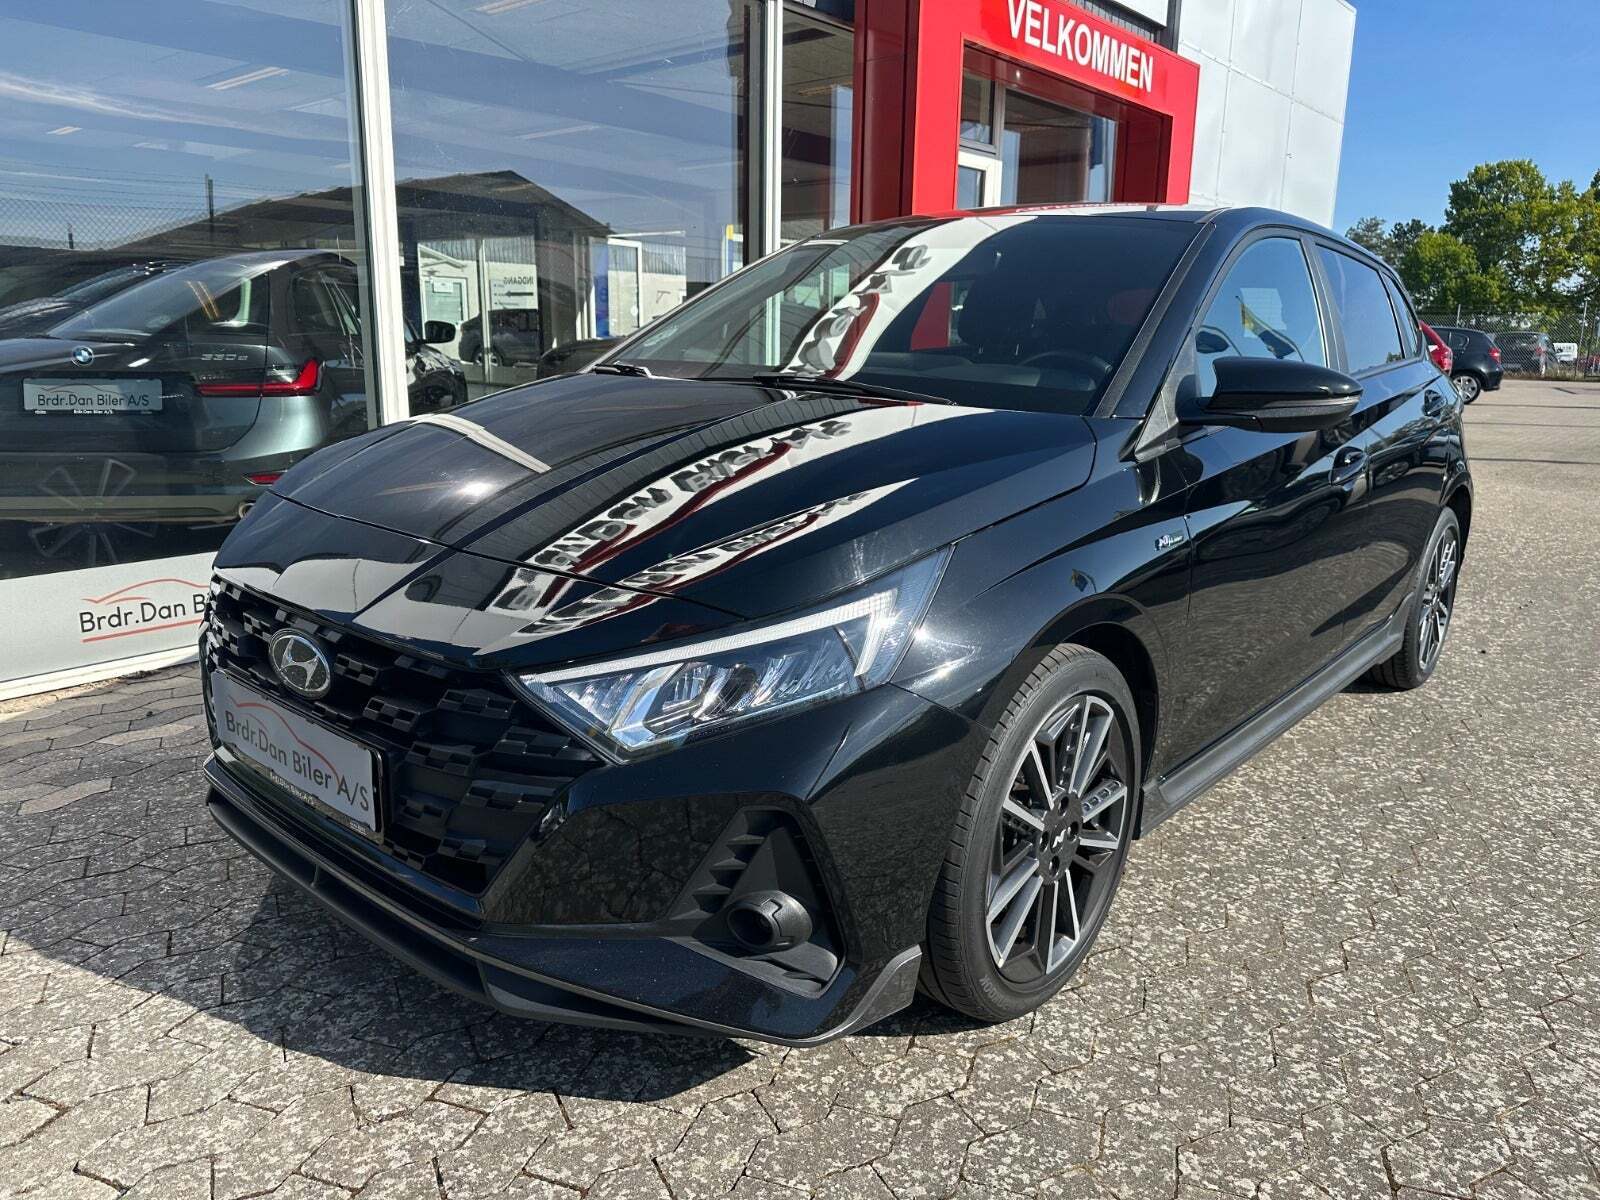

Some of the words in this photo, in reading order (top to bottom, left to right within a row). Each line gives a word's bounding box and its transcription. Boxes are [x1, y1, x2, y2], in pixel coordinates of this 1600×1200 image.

[1007, 0, 1153, 93] VELKOMMEN
[38, 394, 93, 406] Brdr.Dan
[97, 394, 124, 406] Biler
[128, 394, 150, 406] A/S
[79, 602, 186, 633] Brdr.Dan
[224, 710, 288, 766] Brdr.Dan
[292, 752, 332, 789] Biler
[337, 774, 369, 811] A/S
